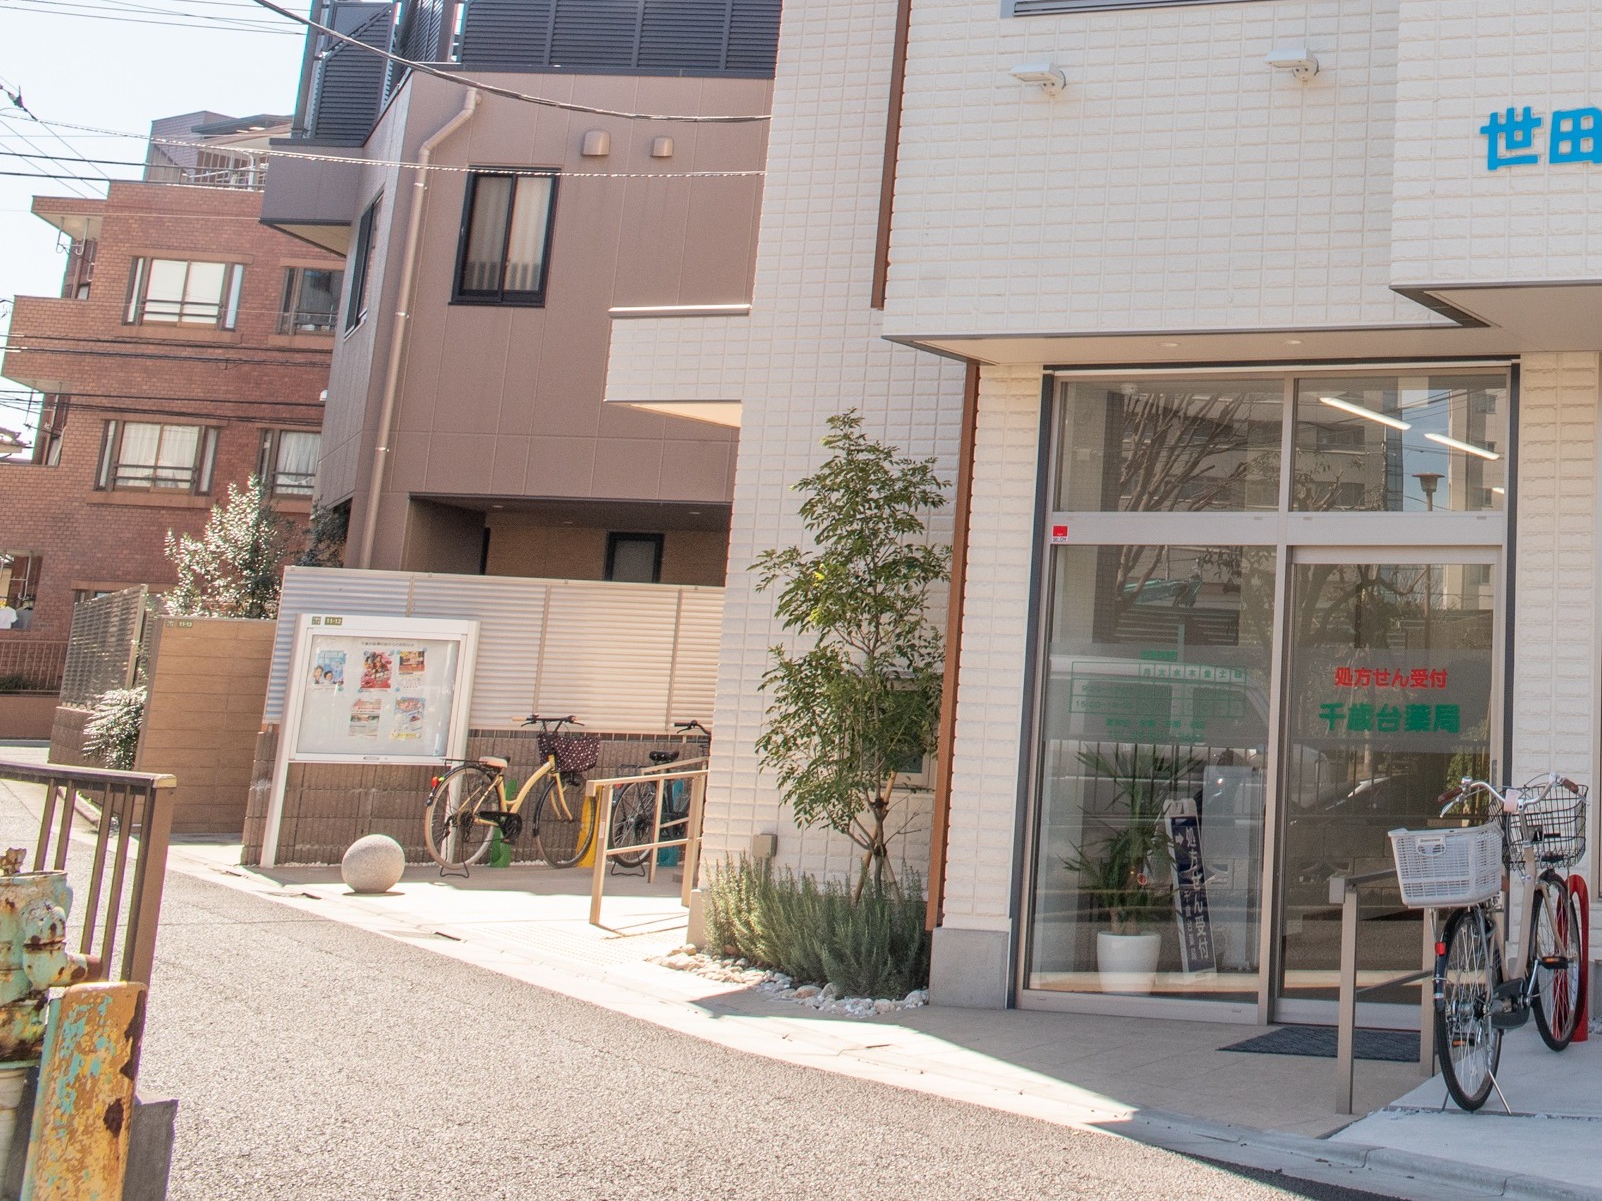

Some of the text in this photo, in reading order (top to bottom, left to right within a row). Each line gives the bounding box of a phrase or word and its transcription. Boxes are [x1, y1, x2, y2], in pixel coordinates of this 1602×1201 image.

[1334, 667, 1448, 689] 処方せん受付
[1319, 703, 1461, 734] 千歳台薬局
[1185, 826, 1209, 959] 処方せん受付
